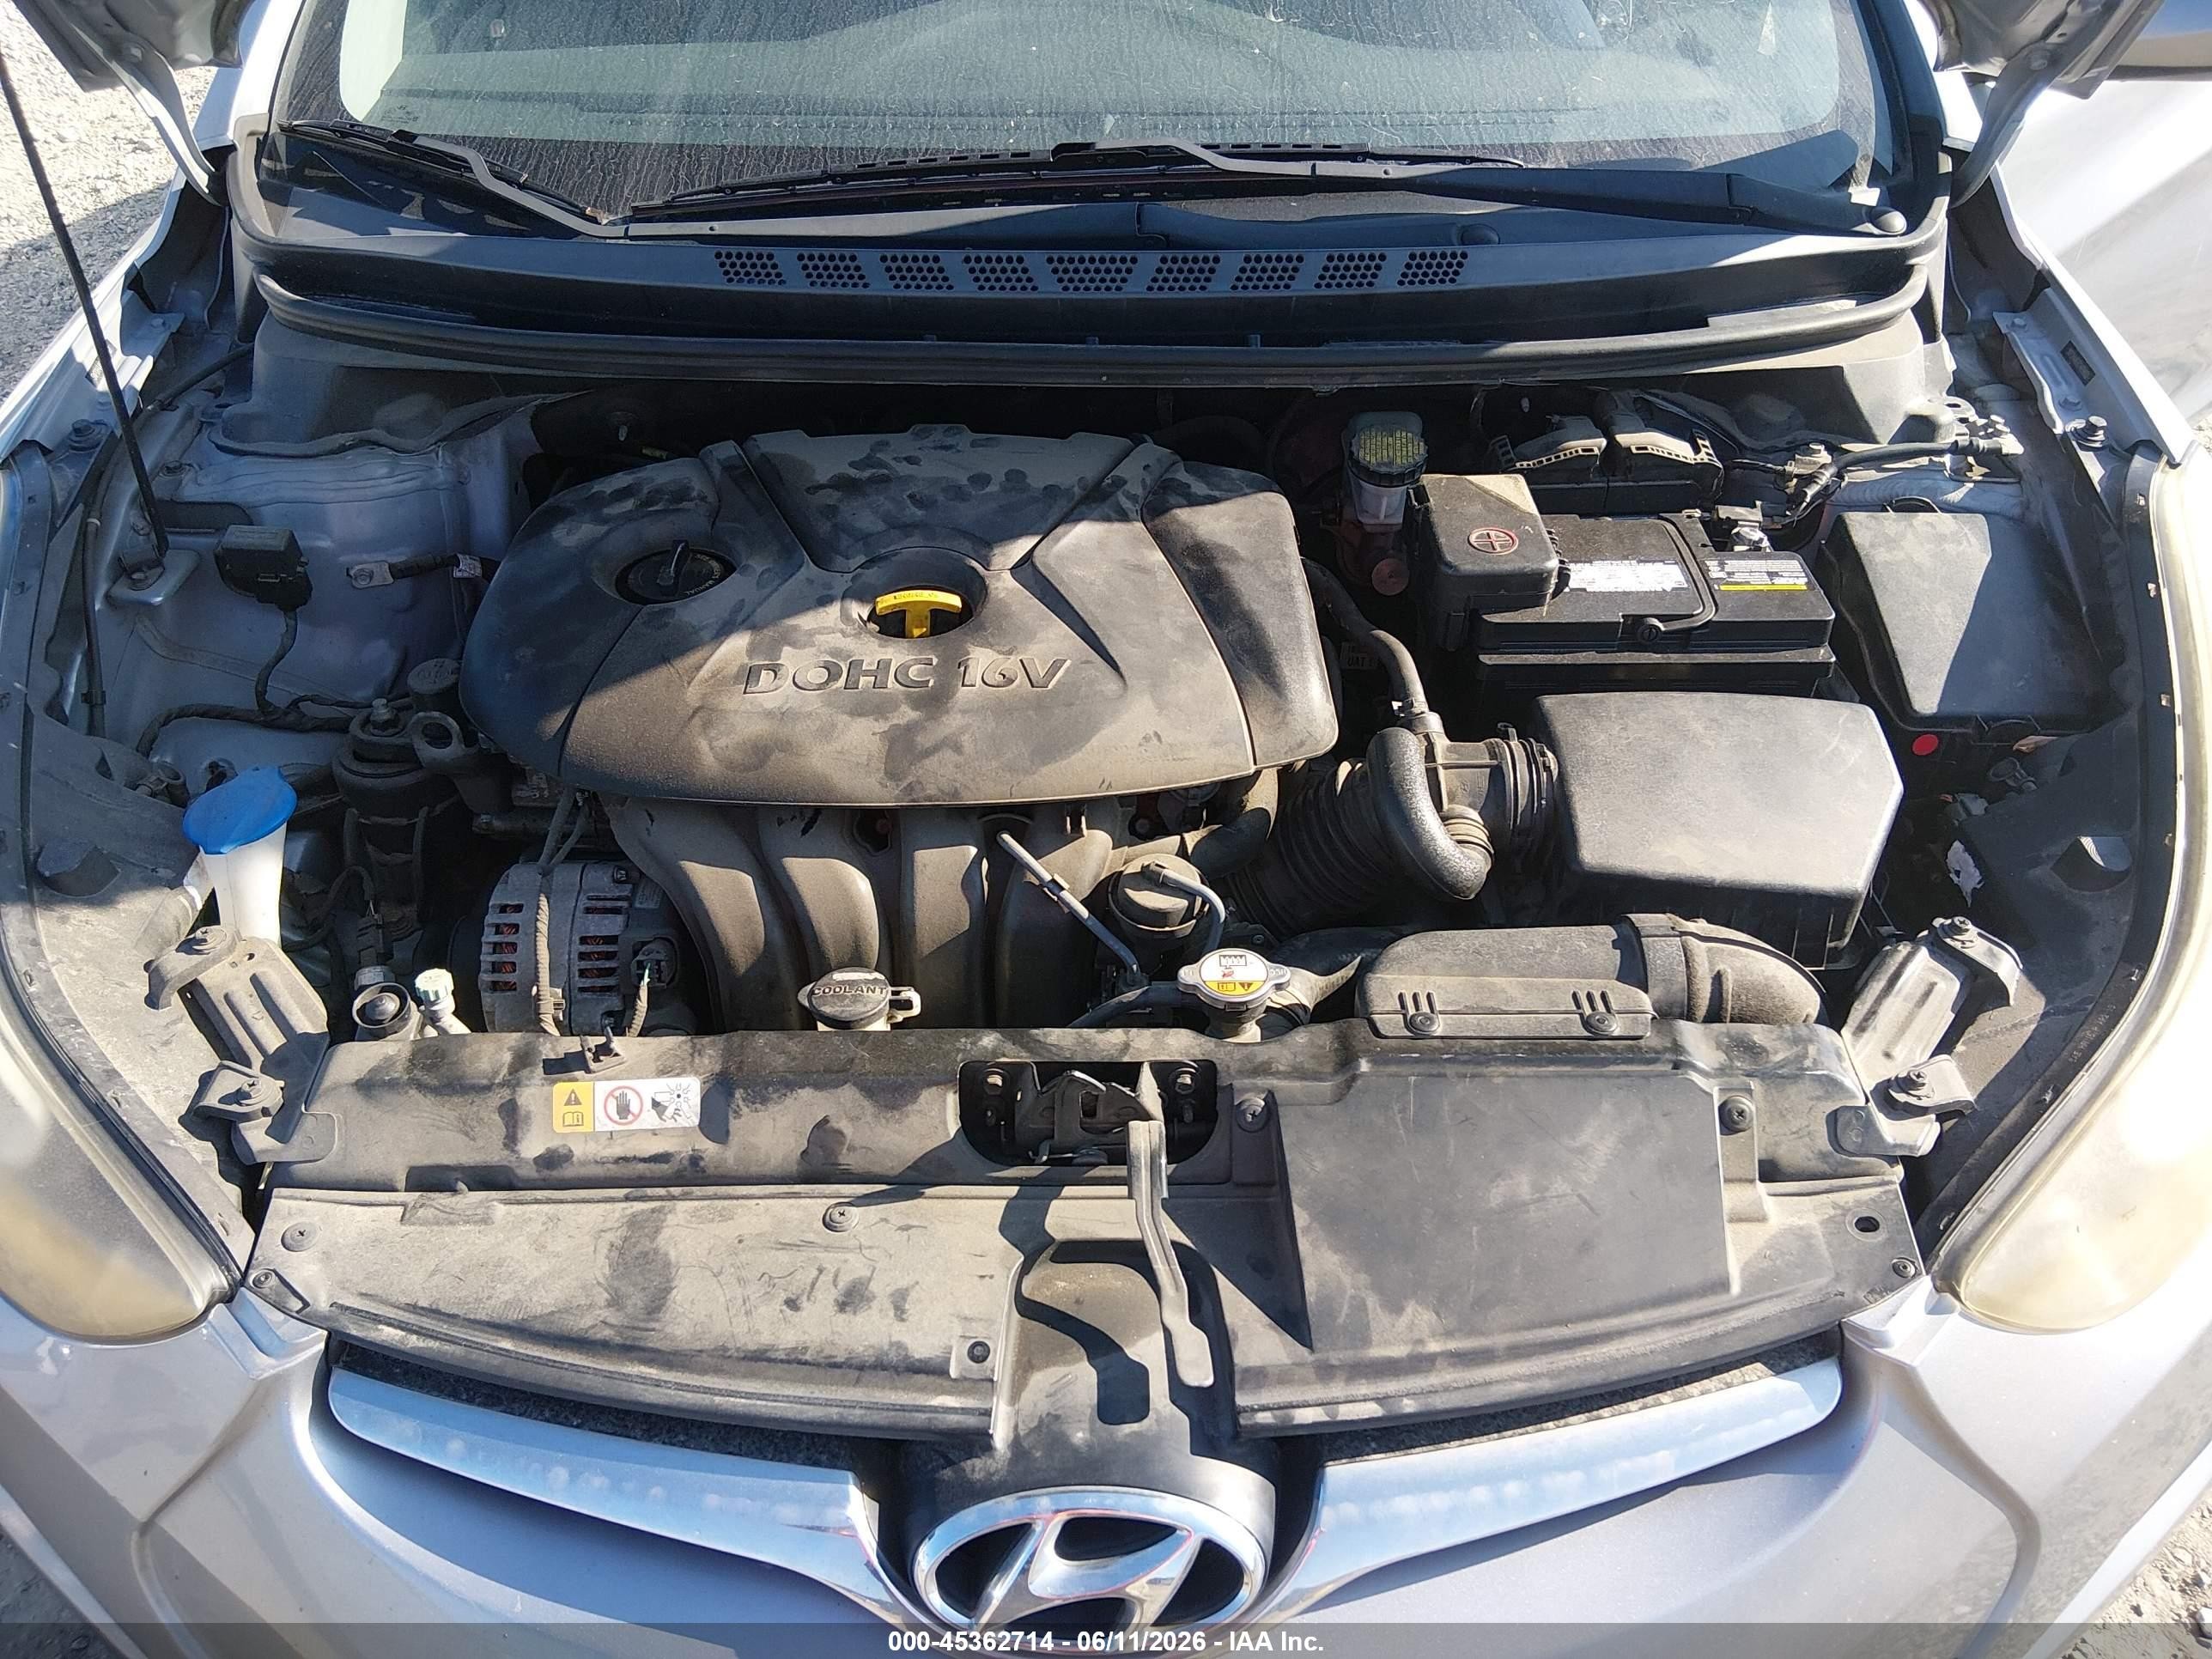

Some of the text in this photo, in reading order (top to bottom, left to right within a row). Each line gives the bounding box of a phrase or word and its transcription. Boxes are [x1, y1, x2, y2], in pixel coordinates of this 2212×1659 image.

[743, 656, 1073, 695] DOHC 16V
[811, 984, 888, 996] COOLANT
